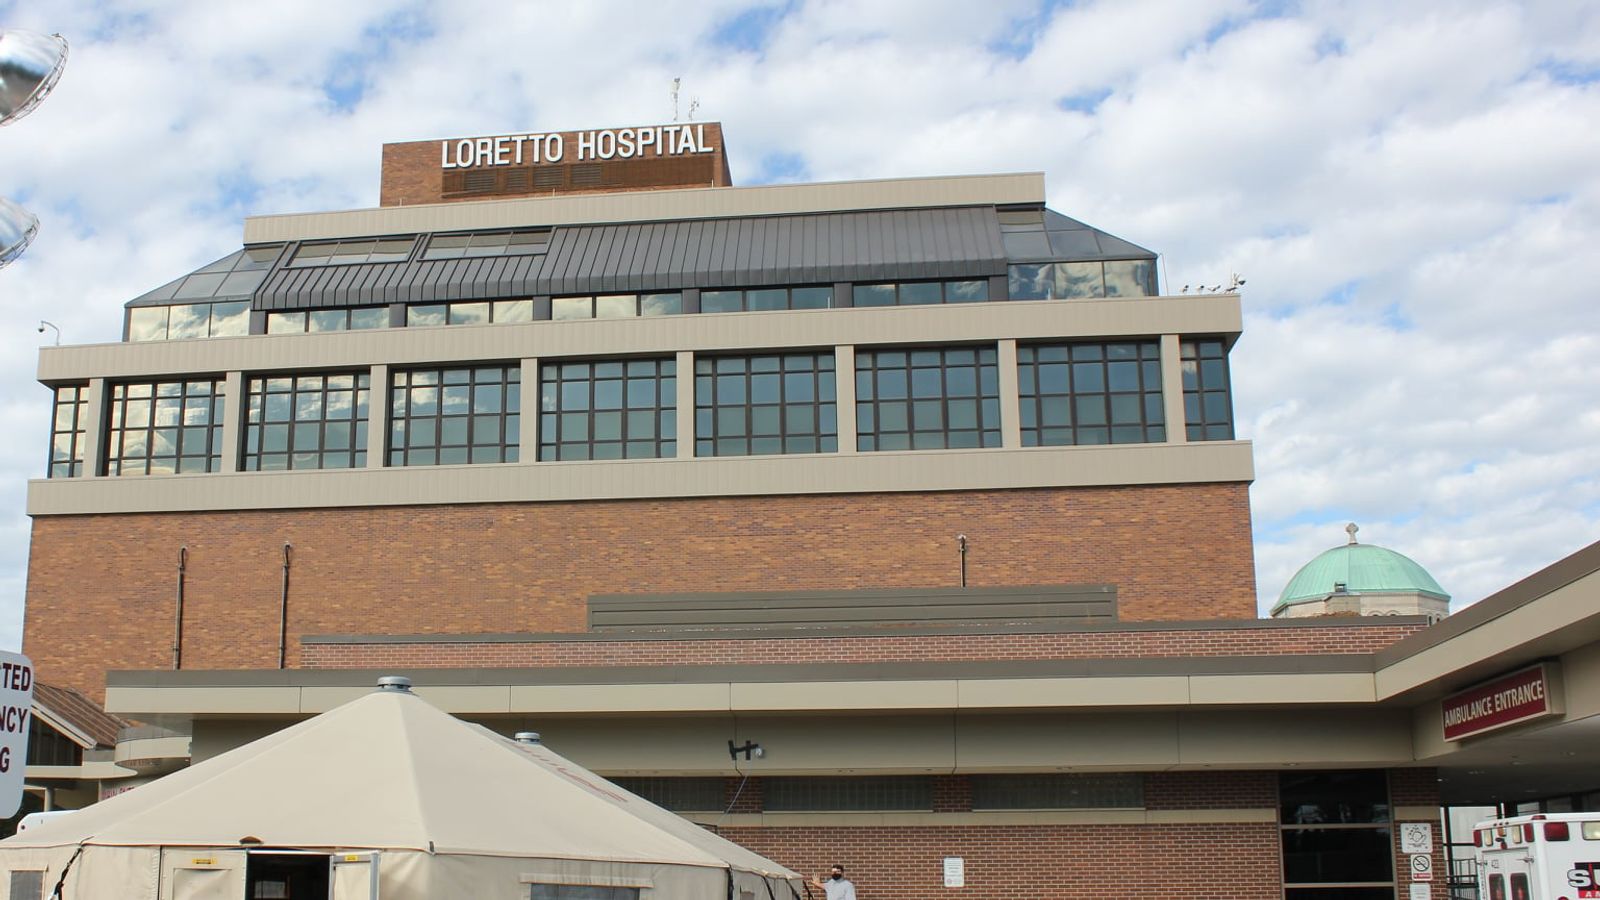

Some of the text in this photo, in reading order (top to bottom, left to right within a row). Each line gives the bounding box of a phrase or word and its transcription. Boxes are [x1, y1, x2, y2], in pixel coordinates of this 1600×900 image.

[442, 124, 713, 169] LORETTO HOSPITAL
[0, 662, 31, 692] TED
[1445, 681, 1543, 727] AMBULANCE ENTRANCE
